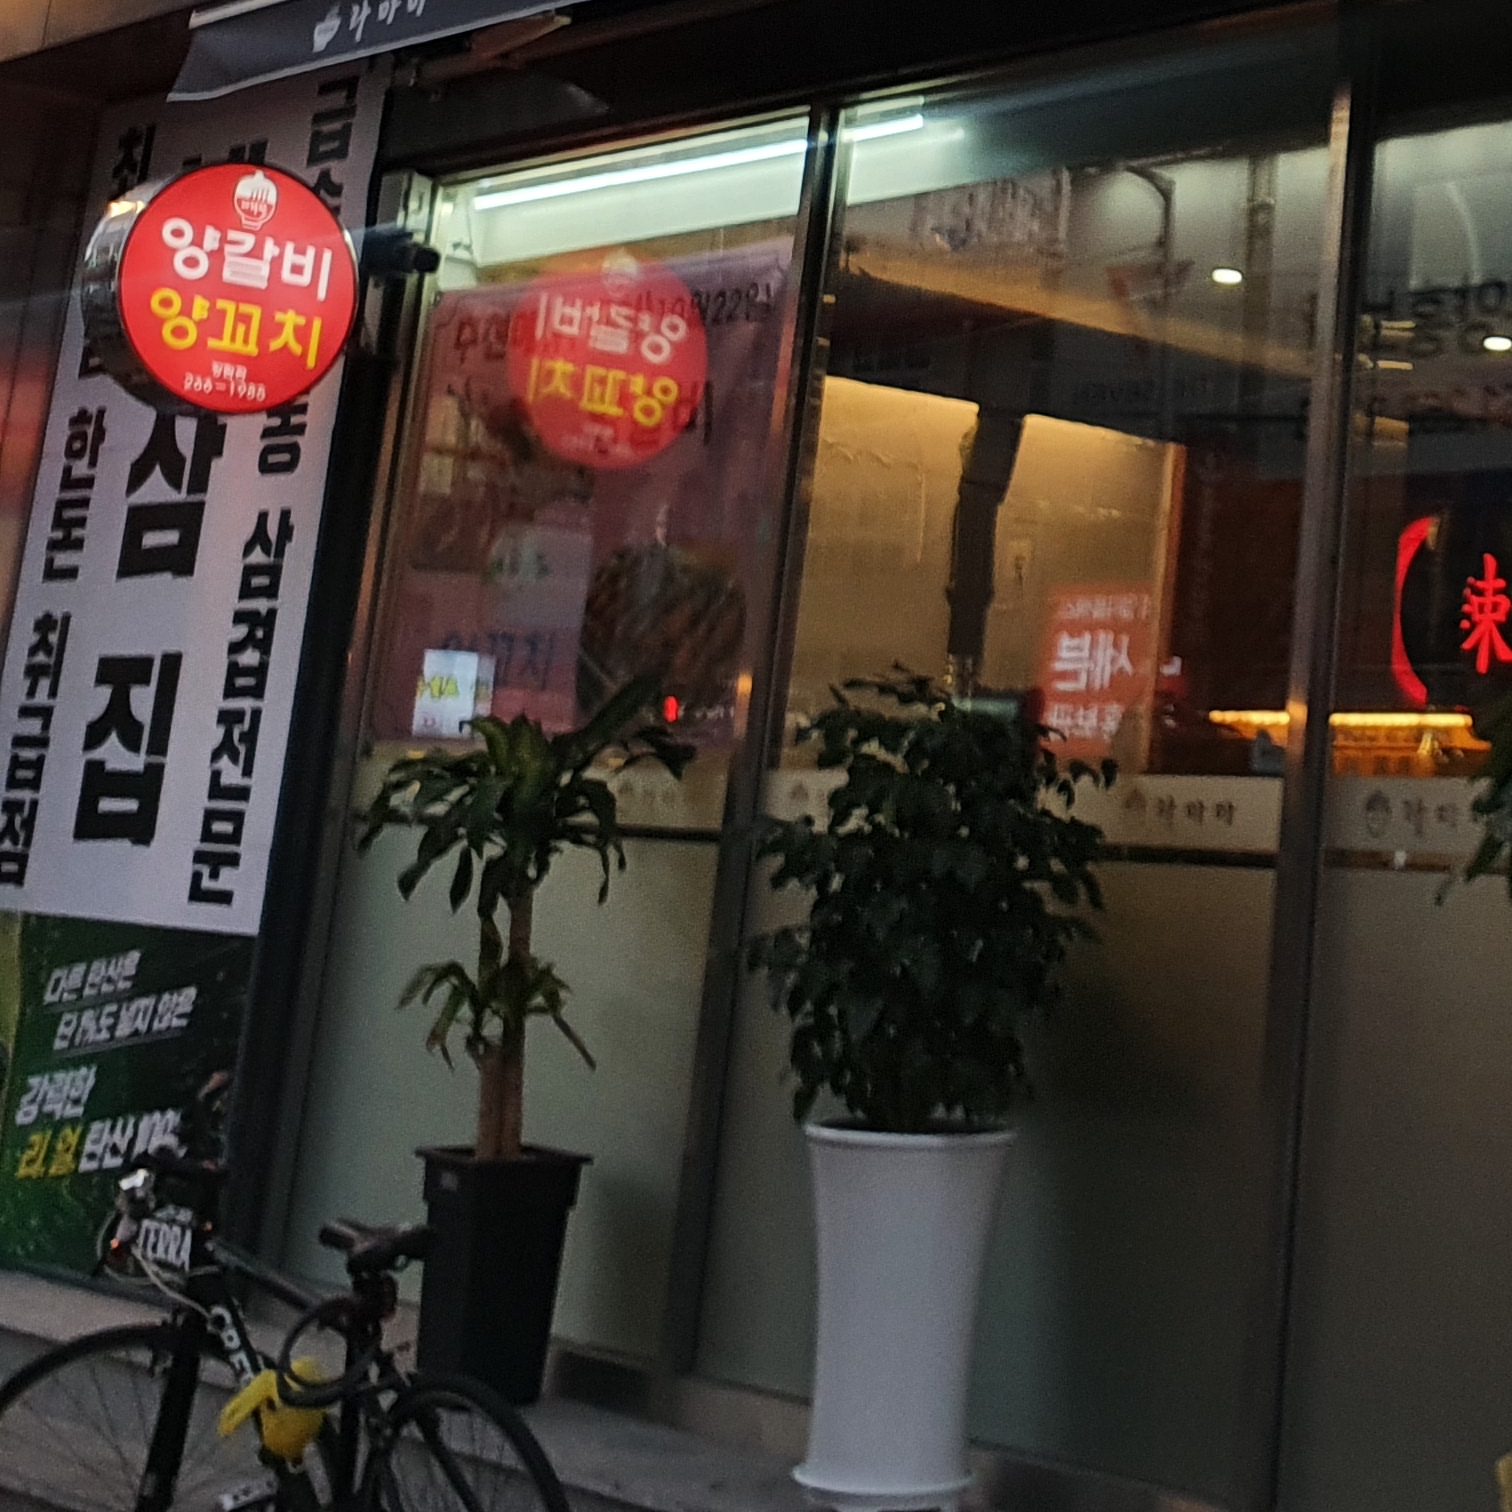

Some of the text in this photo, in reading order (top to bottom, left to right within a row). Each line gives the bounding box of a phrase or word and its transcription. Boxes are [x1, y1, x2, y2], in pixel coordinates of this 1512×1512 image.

[150, 287, 322, 370] 양꼬치
[161, 217, 333, 302] 양갈비
[0, 405, 106, 888] 한돈 취급점
[187, 508, 295, 908] 삼겹전문
